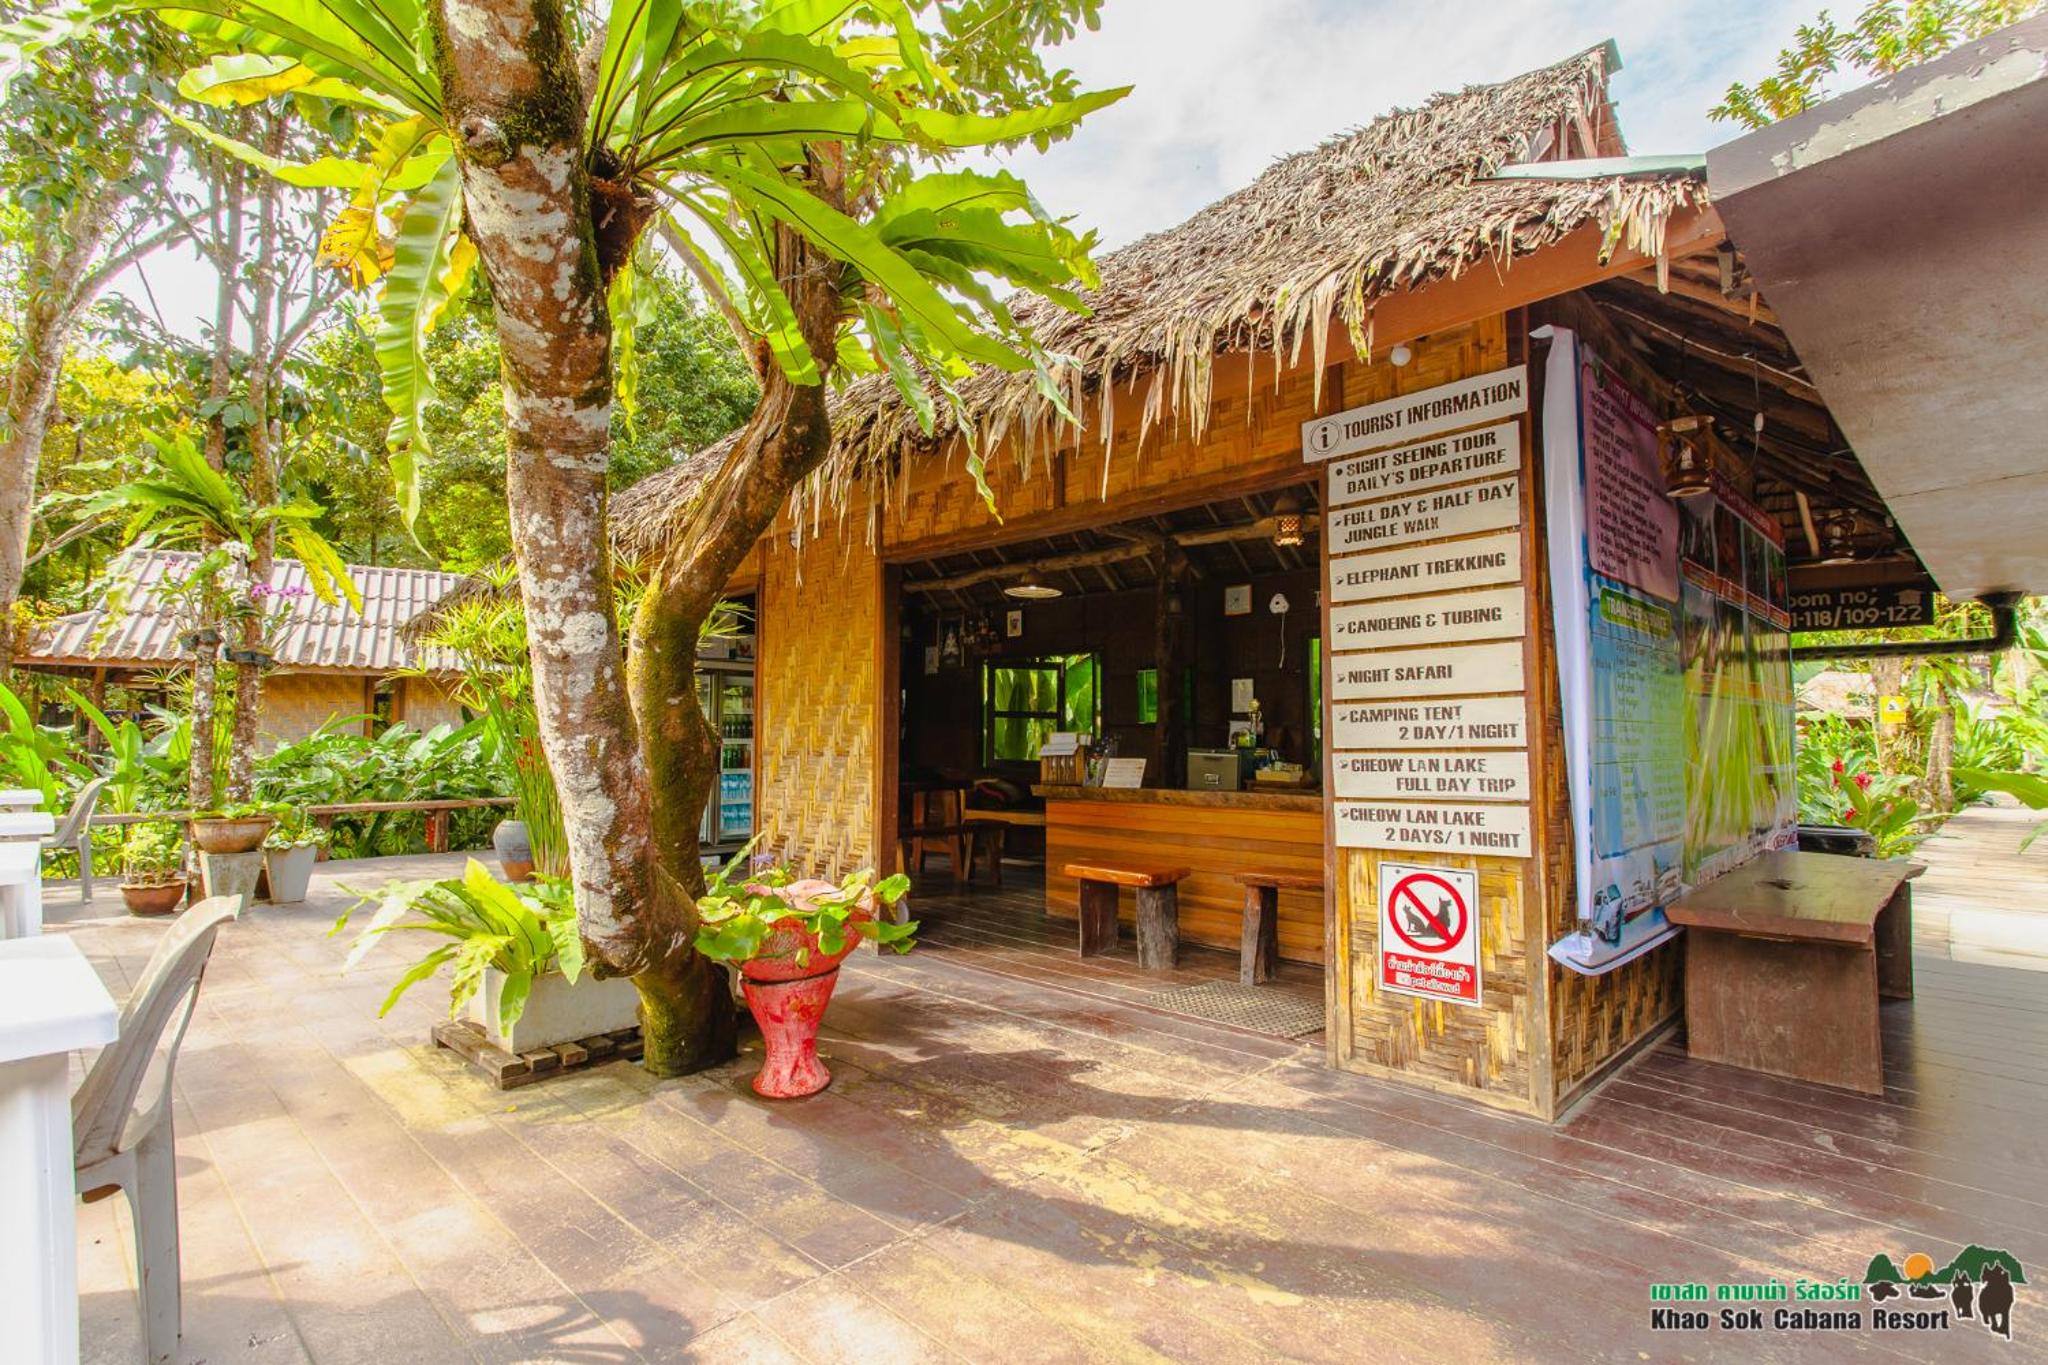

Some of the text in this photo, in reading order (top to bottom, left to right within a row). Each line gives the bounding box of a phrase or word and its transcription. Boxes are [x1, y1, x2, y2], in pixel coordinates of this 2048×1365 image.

[1343, 410, 1404, 440] TOURIST
[1407, 379, 1521, 424] INFORMATION
[1346, 431, 1496, 477] SIGHT SEEING TOUR
[1347, 448, 1507, 494] DAILY'S DEPARTURE
[1343, 483, 1515, 527] FULL DAY & HALF DAY
[1344, 516, 1439, 544] JUNGLE WALK
[1347, 552, 1506, 586] ELEPHANT TREKKING
[1789, 592, 1832, 607] oom
[1347, 606, 1502, 635] CANOEING & TUBING
[1790, 604, 1923, 628] 1-118/109-122
[1348, 664, 1452, 685] NIGHT SAFARI
[1349, 705, 1463, 724] CAMPING TENT
[1399, 726, 1409, 741] 2
[1468, 723, 1519, 739] NIGHT
[1351, 758, 1487, 773] CHEOW LAN LAKE
[1396, 777, 1517, 793] FULL DAY TRIP
[1350, 807, 1485, 827] CHEOW LAN LAKE
[1385, 827, 1396, 842] 2
[1458, 831, 1465, 845] 1
[1470, 832, 1521, 849] NIGHT
